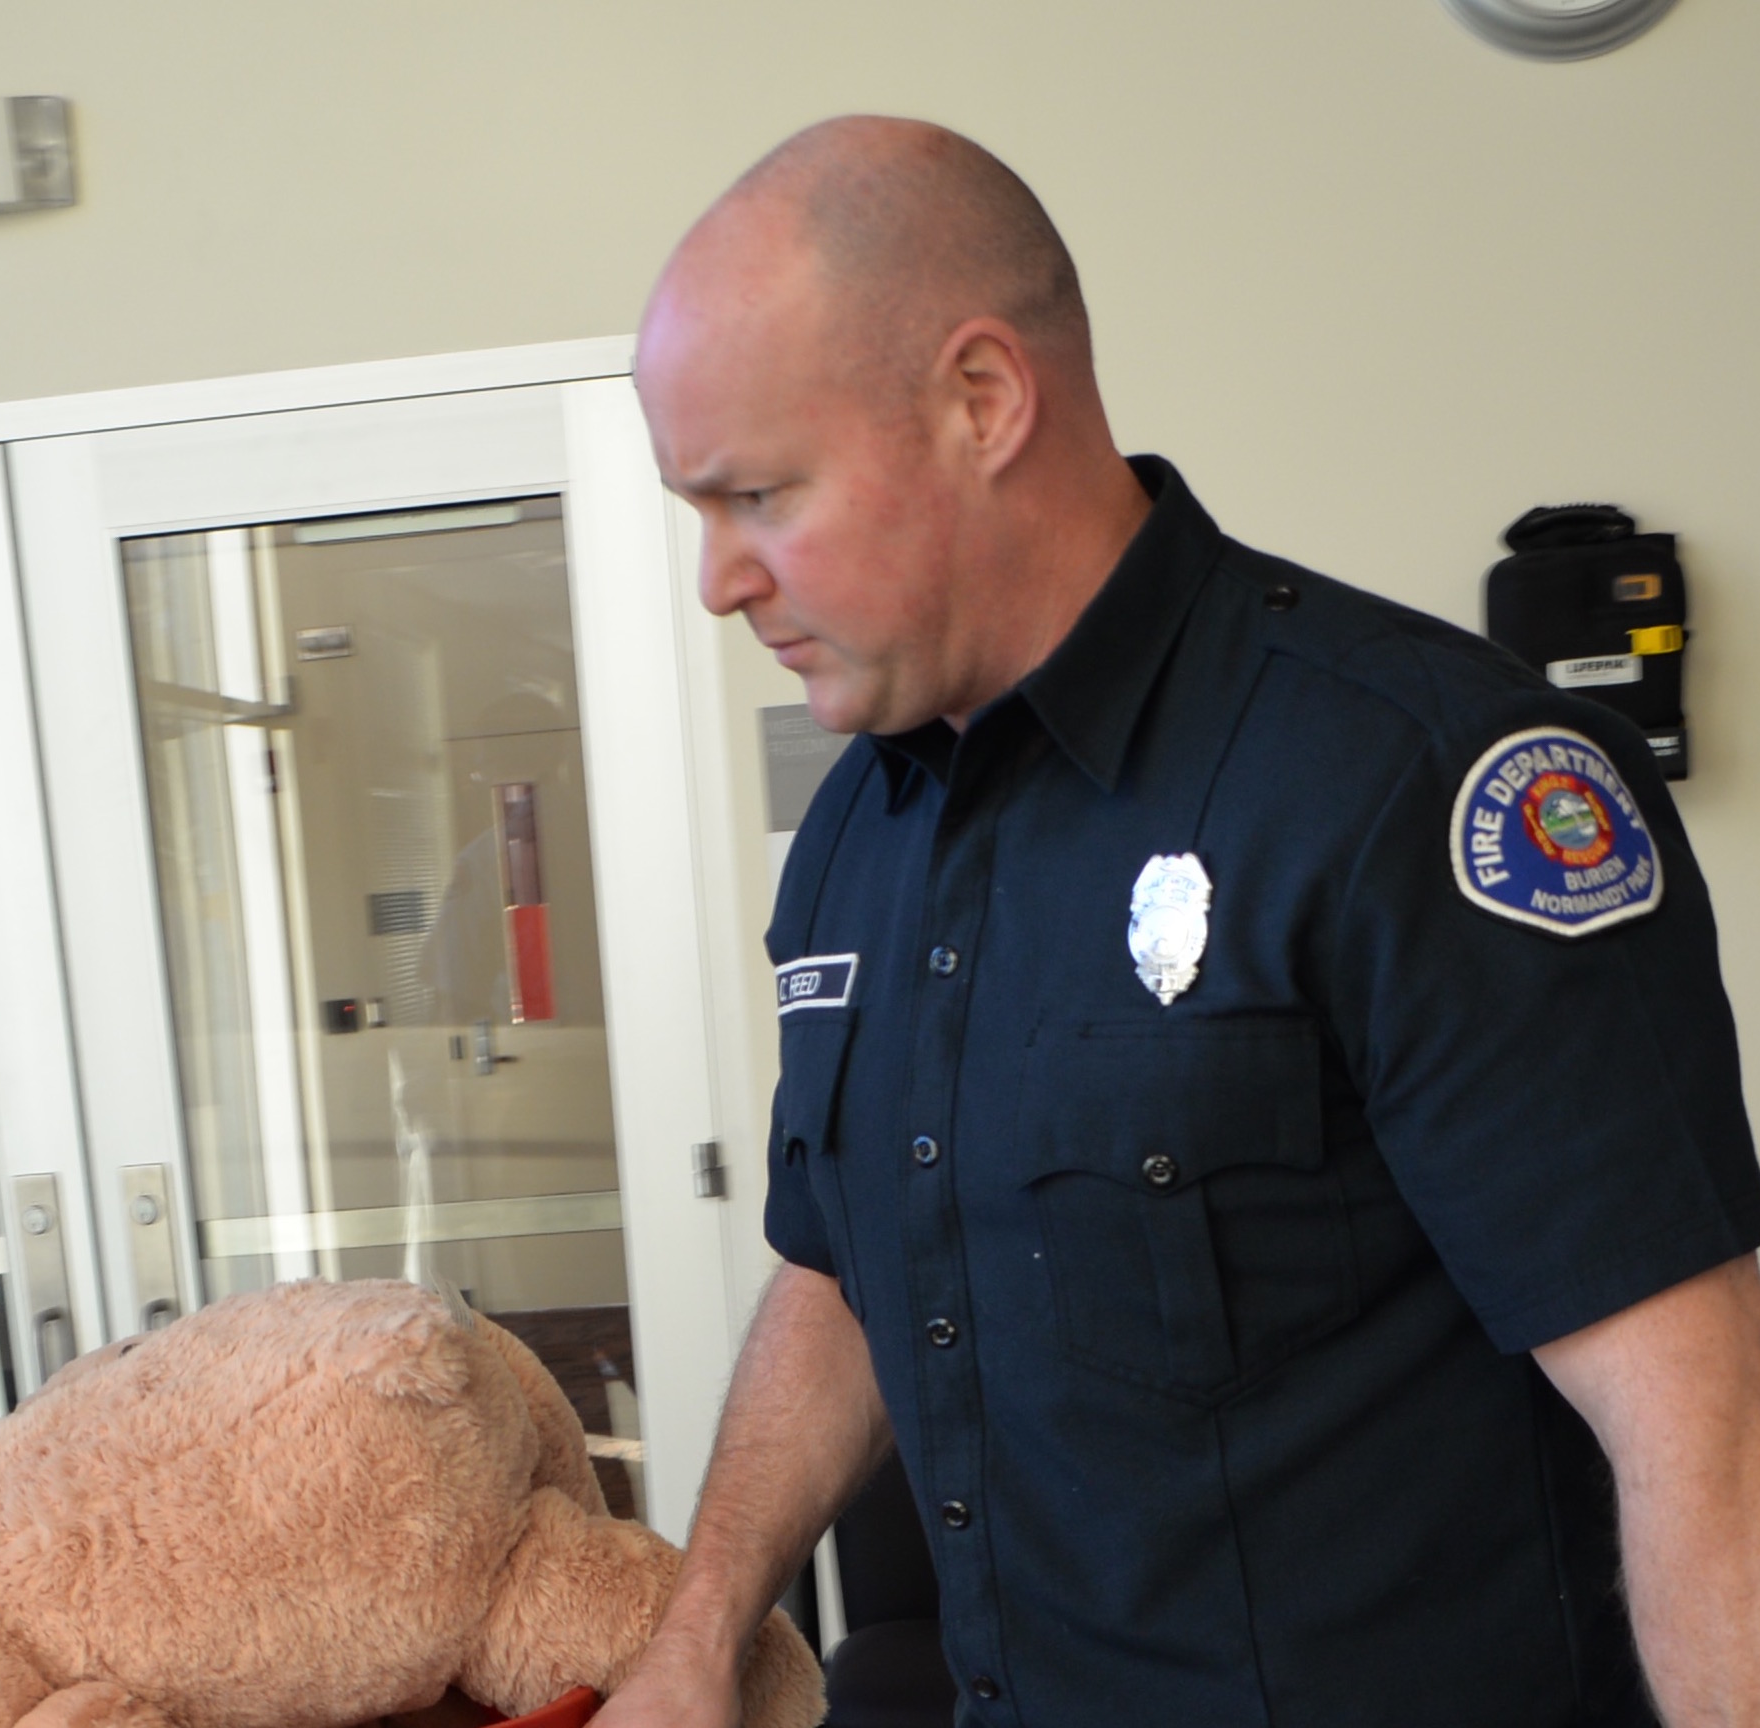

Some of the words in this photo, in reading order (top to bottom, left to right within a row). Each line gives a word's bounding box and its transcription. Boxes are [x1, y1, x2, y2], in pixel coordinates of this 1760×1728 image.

[1484, 743, 1642, 830] DEPARTMENT
[1471, 806, 1511, 888] FIRE
[1563, 855, 1627, 892] BURIEN
[1529, 883, 1630, 914] NORMANDY
[788, 971, 822, 1000] REED
